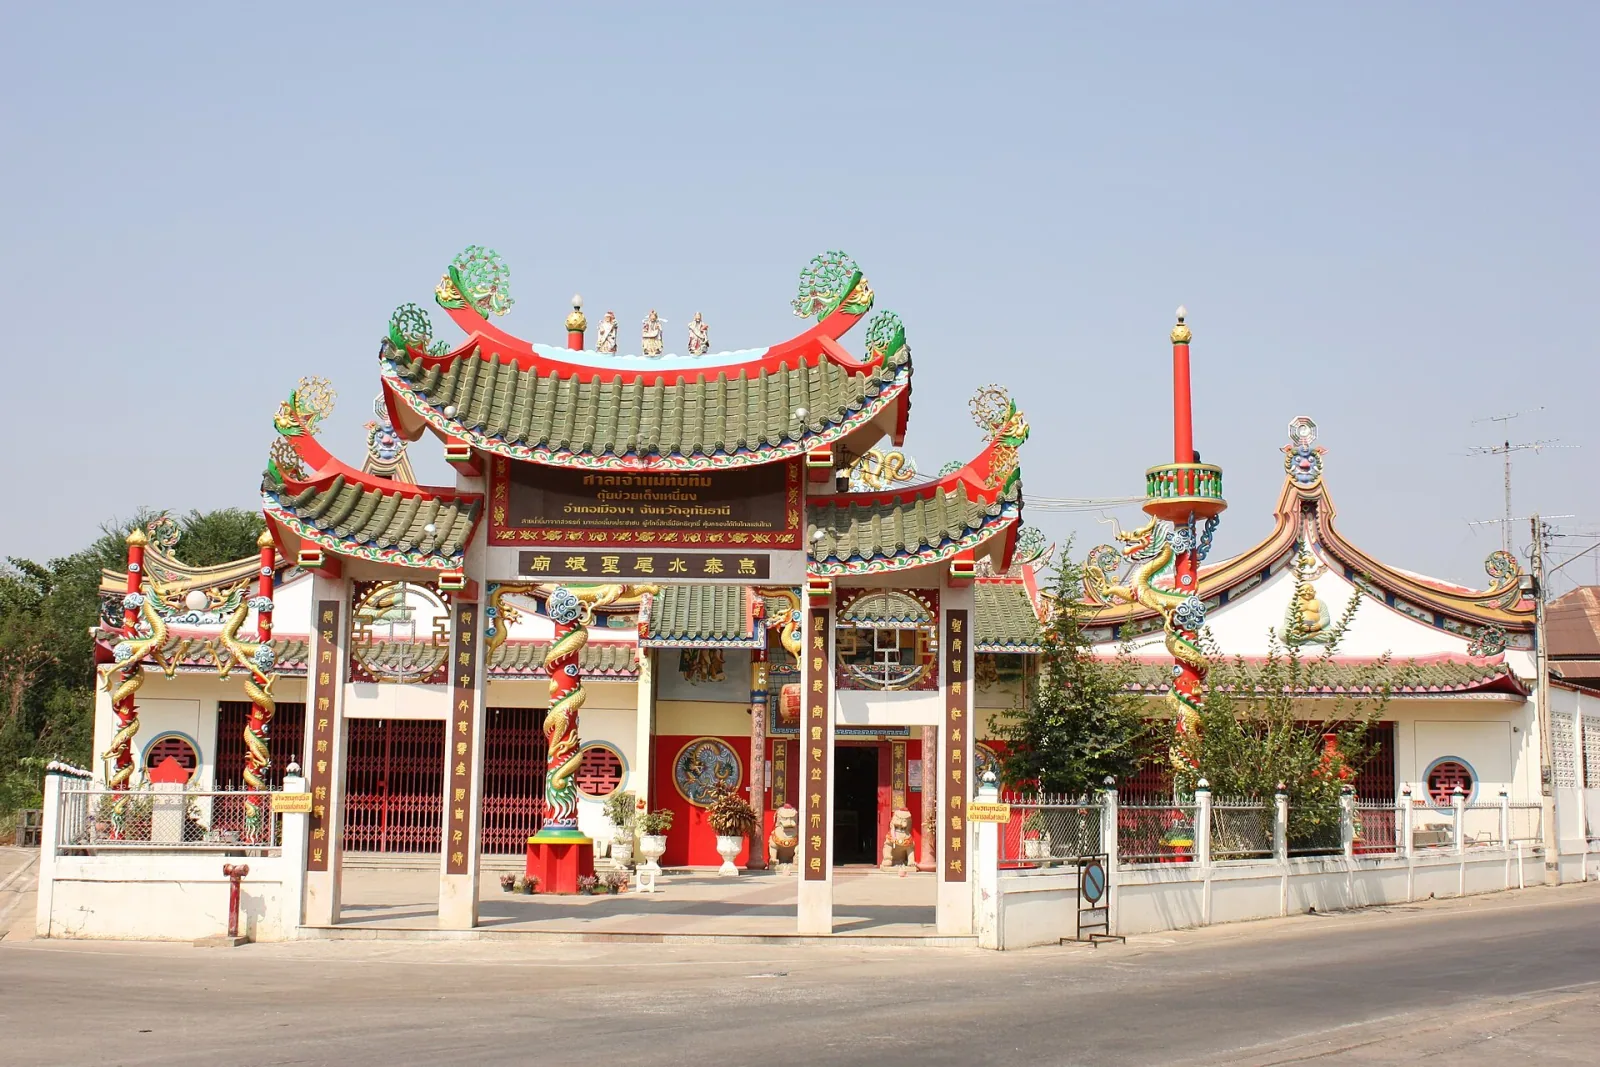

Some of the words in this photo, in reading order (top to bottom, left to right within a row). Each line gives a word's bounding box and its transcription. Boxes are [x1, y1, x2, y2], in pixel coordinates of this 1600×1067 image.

[583, 472, 712, 487] ศาลเจ้าแม่ทับทิม
[563, 502, 635, 515] อำเภอเมืองฯ
[640, 504, 731, 518] จังหวัดอุทัยธานี
